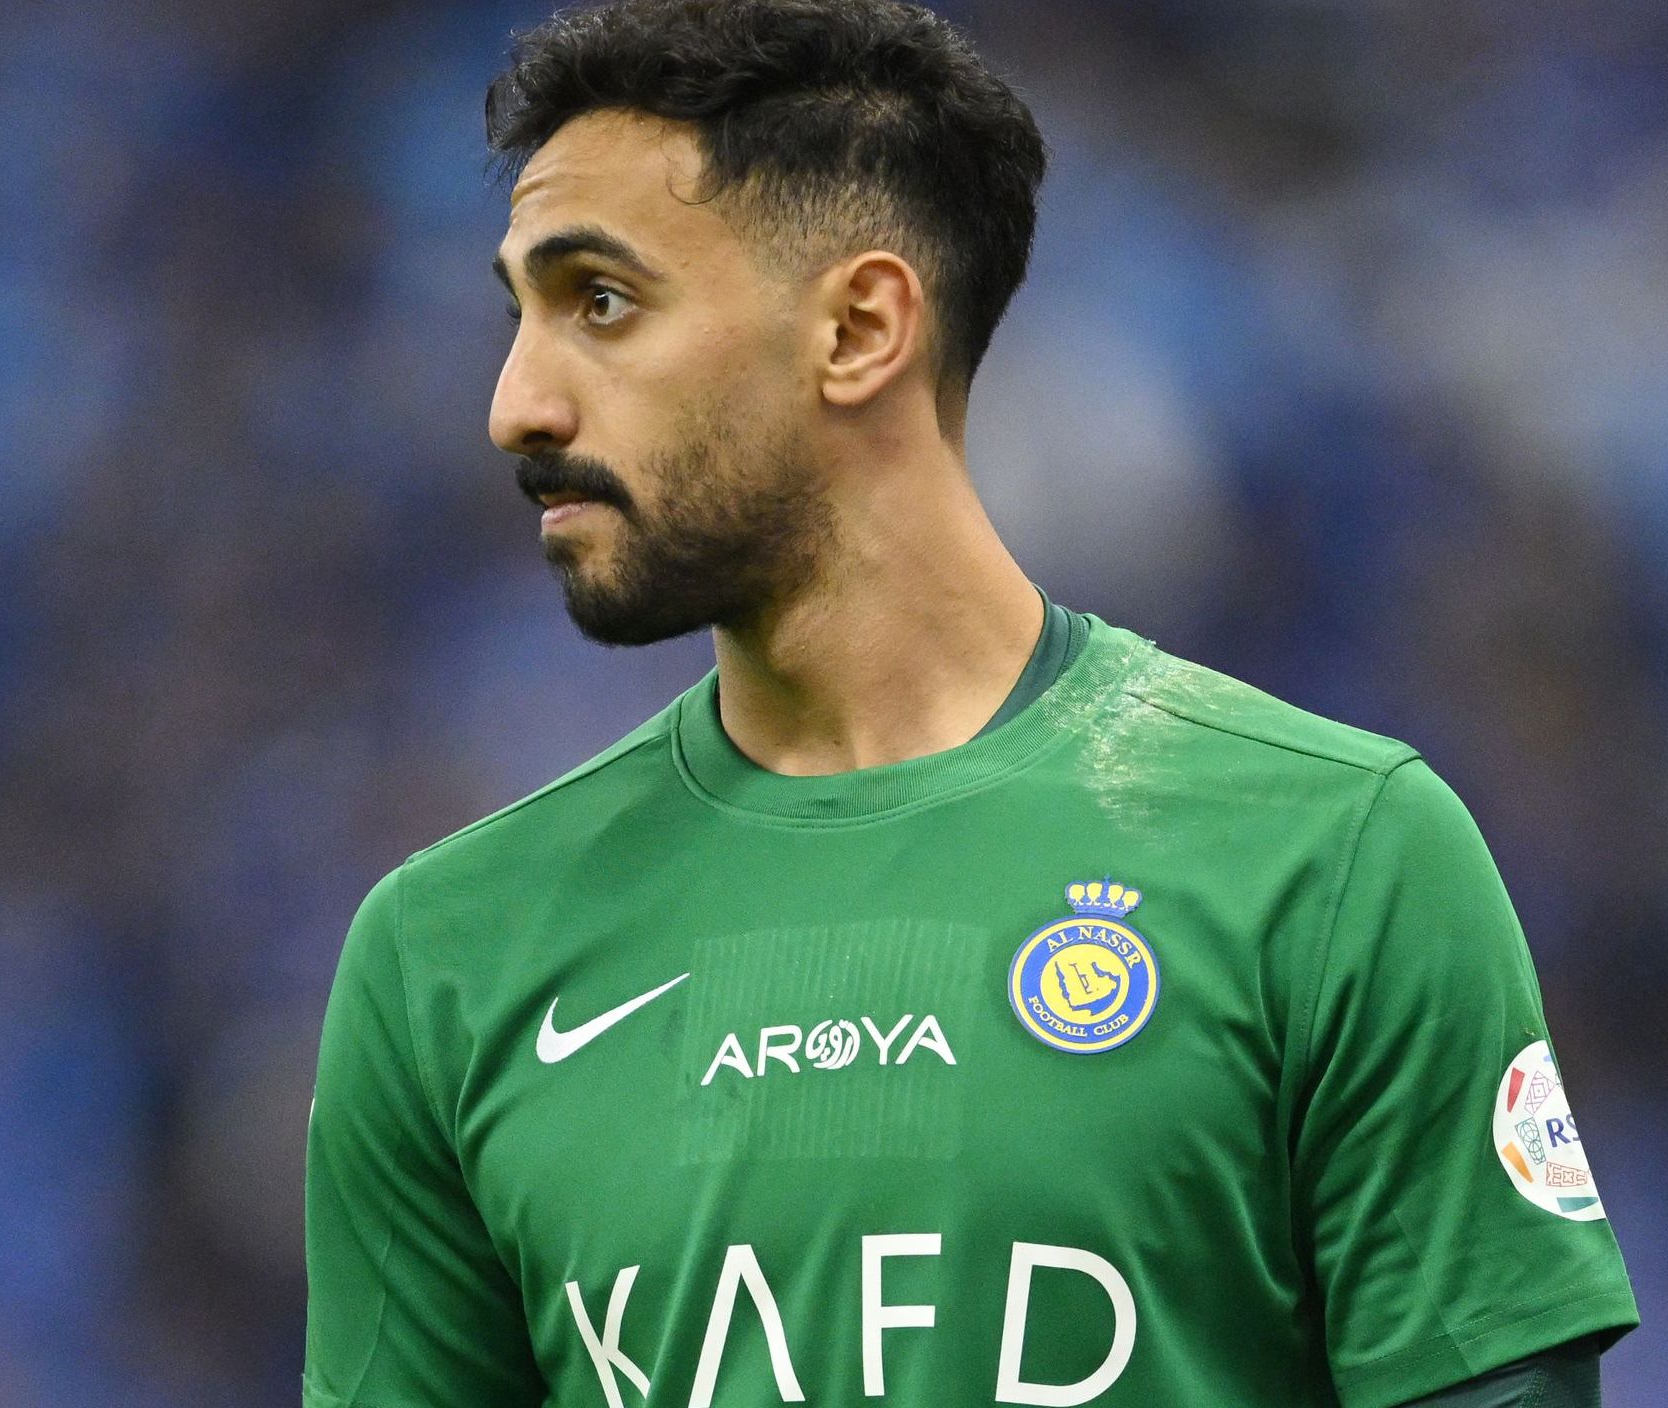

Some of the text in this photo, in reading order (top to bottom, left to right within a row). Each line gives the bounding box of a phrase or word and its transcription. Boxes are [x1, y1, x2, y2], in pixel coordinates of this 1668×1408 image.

[1045, 926, 1143, 969] AL NASSR
[1028, 995, 1130, 1038] FOOTBALL CLUB
